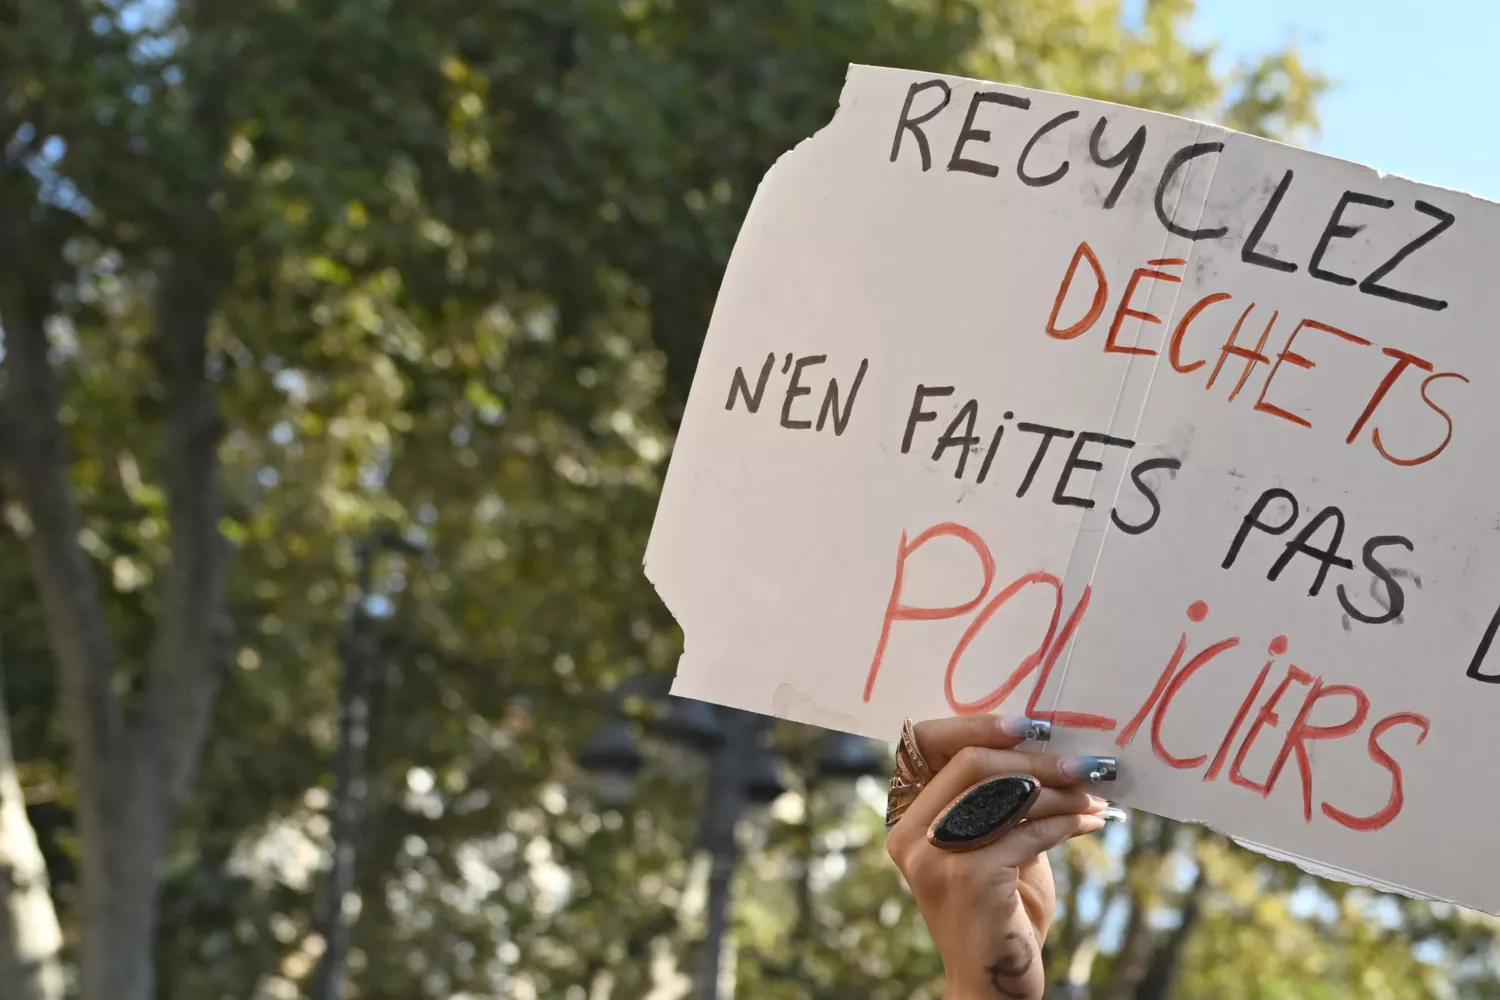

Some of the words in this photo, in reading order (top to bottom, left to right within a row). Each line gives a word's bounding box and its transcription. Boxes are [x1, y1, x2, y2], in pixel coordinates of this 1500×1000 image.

[889, 79, 1455, 311] RECYCLEZ
[1045, 241, 1470, 466] DÉCHETS
[725, 352, 868, 436] N'EN
[1220, 487, 1416, 626] PAS
